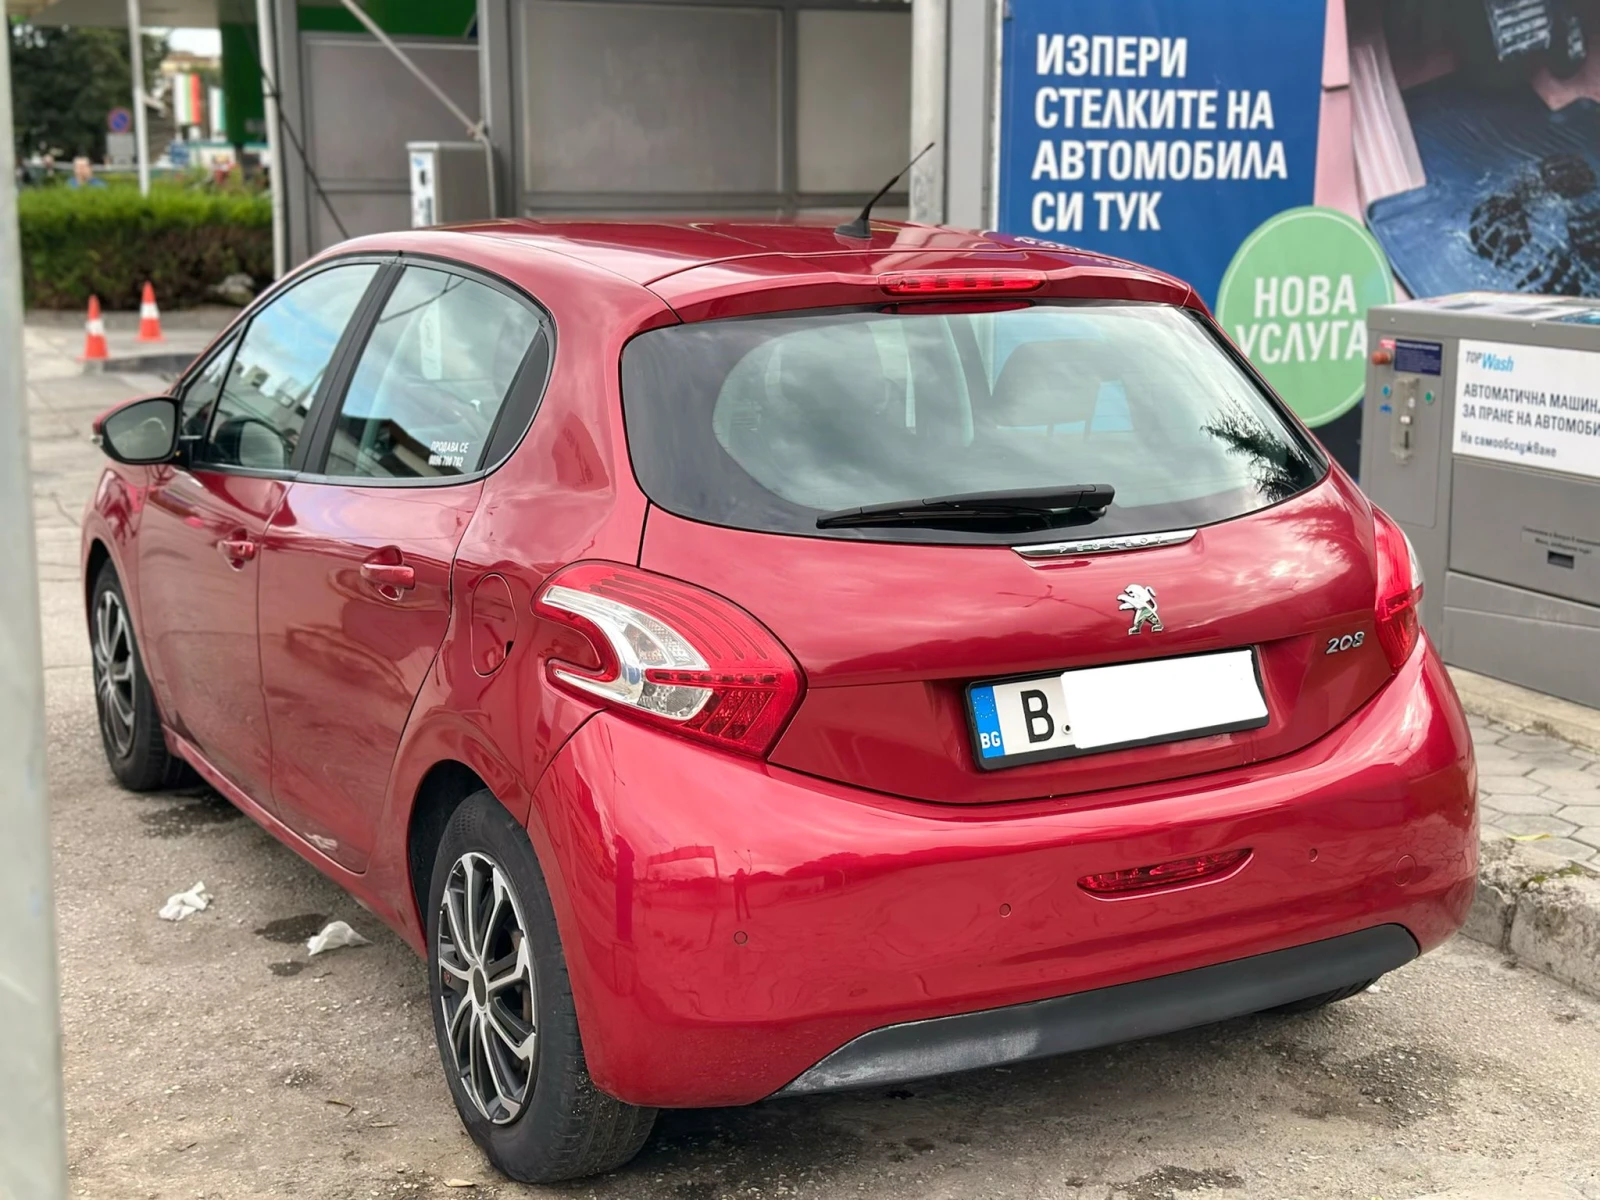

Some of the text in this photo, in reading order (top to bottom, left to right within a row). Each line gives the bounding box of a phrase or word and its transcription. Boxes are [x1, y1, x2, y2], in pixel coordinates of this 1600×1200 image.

[1036, 34, 1188, 78] ИЗПЕРИ
[1034, 87, 1275, 130] СТЕЛКИТЕ НА
[1031, 140, 1288, 181] АВТОМОБИЛА
[1031, 191, 1163, 233] СИ ТУК
[1254, 274, 1358, 319] НОВА
[1235, 319, 1368, 364] УСЛУГА
[1463, 383, 1547, 407] АВТОМАТИЧНА
[1462, 403, 1476, 419] ЗА
[1479, 406, 1514, 424] ПРАНЕ
[1516, 411, 1532, 427] НА
[430, 440, 469, 453] ПРОДАВА СЕ
[1461, 431, 1472, 444] На
[1059, 535, 1164, 554] PEUGEOT
[1325, 631, 1365, 655] 208
[1020, 689, 1055, 744] B
[980, 731, 1001, 749] BG
